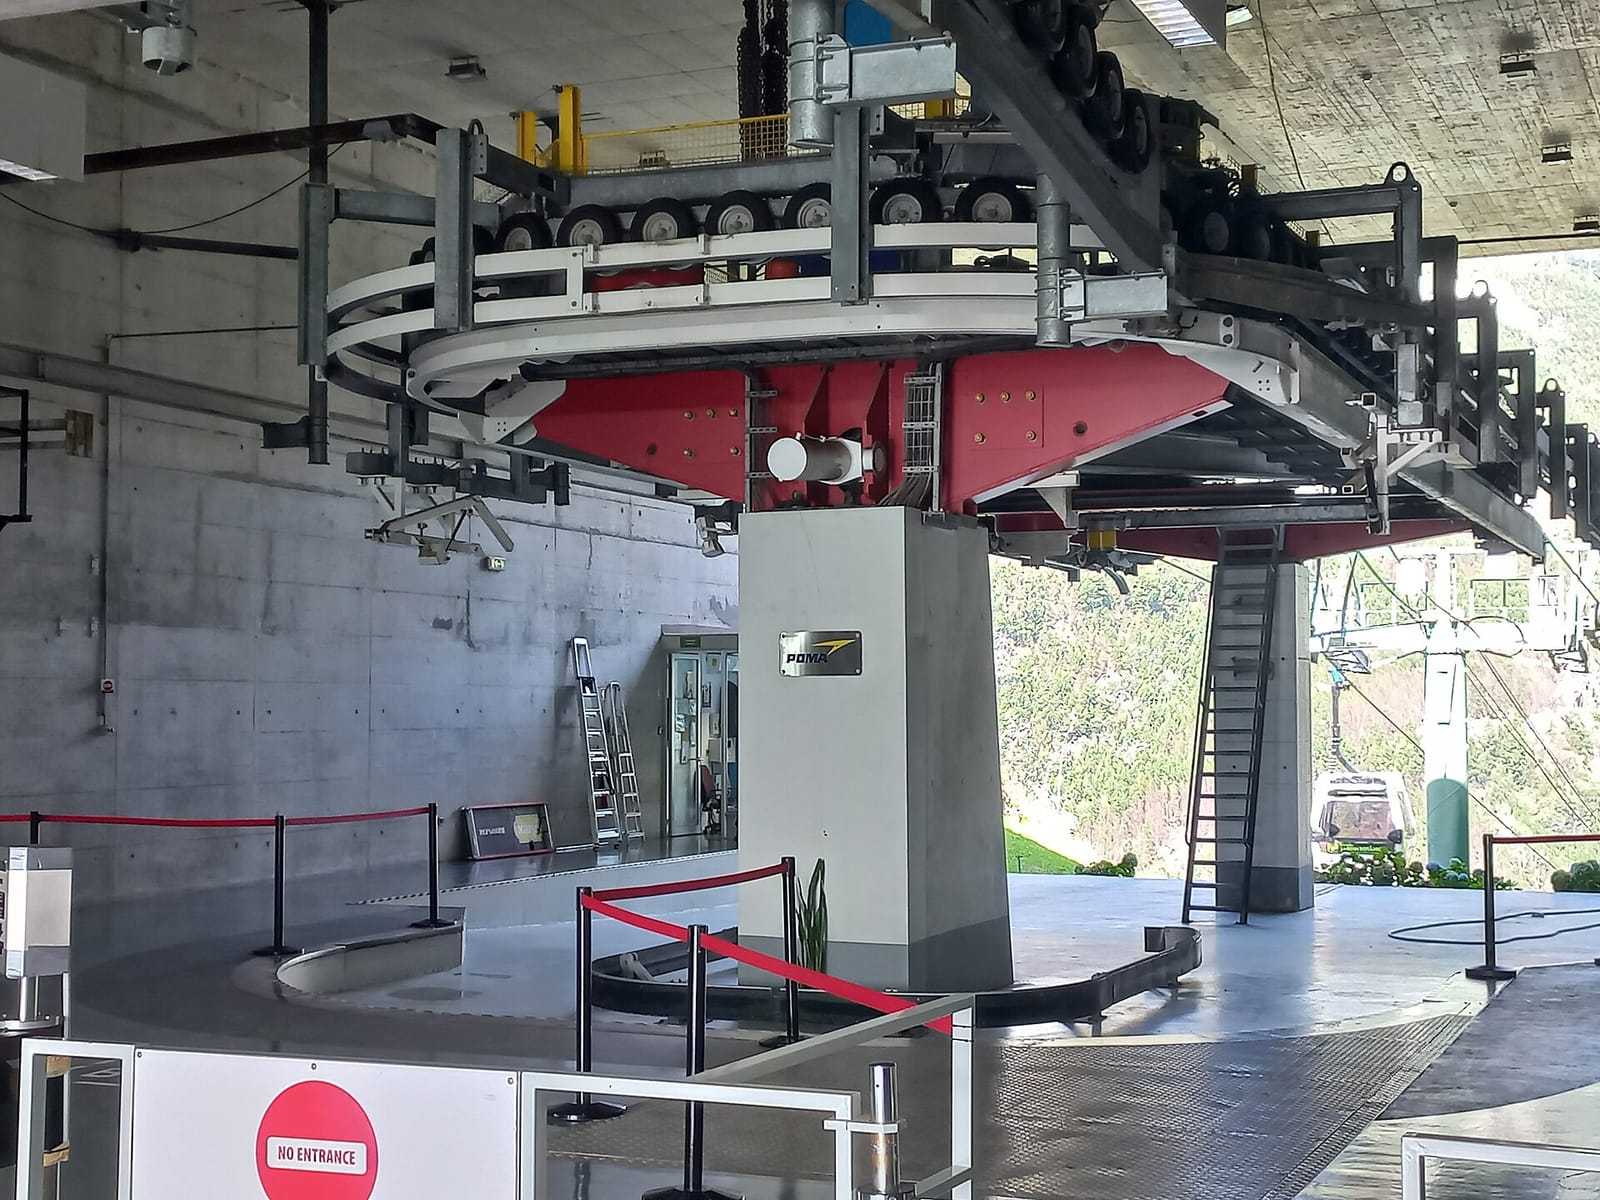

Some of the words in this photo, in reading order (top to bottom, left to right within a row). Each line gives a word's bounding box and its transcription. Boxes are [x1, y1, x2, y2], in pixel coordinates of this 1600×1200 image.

[786, 653, 828, 664] POMA
[278, 1145, 294, 1161] NO
[297, 1147, 356, 1166] ENTRANCE
